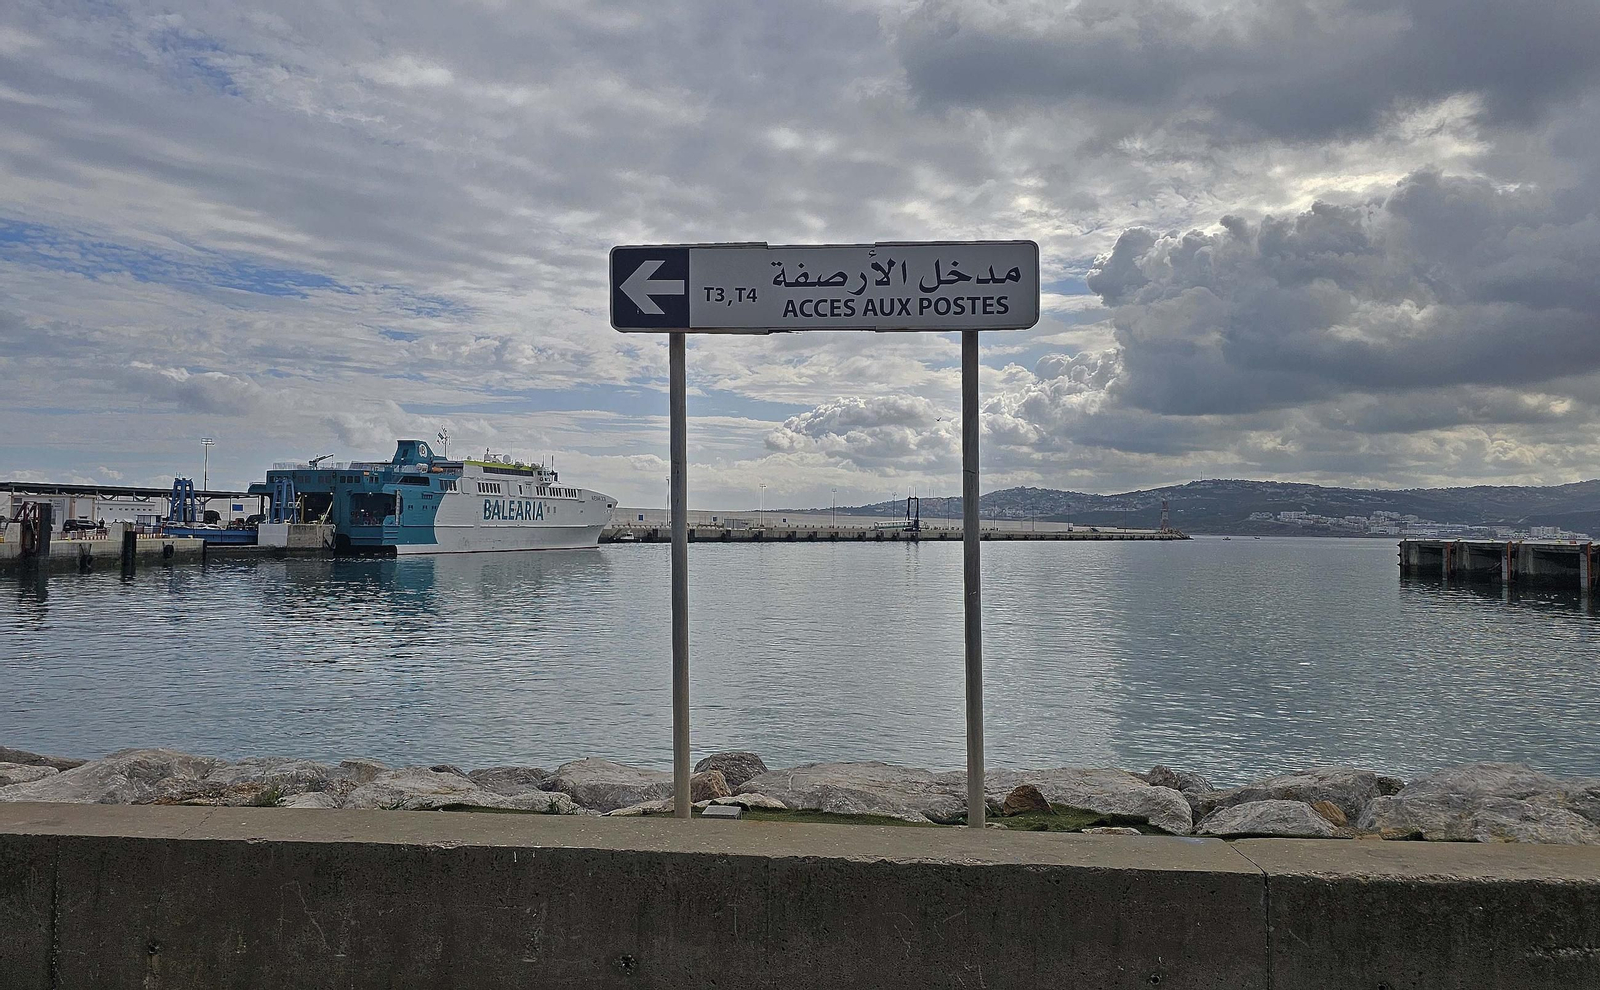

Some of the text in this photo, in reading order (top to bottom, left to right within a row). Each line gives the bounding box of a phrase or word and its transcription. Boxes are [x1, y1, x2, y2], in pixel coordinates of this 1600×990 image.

[771, 250, 1021, 296] مدخل الأرصفة
[782, 296, 1009, 318] ACCES AUX POSTES
